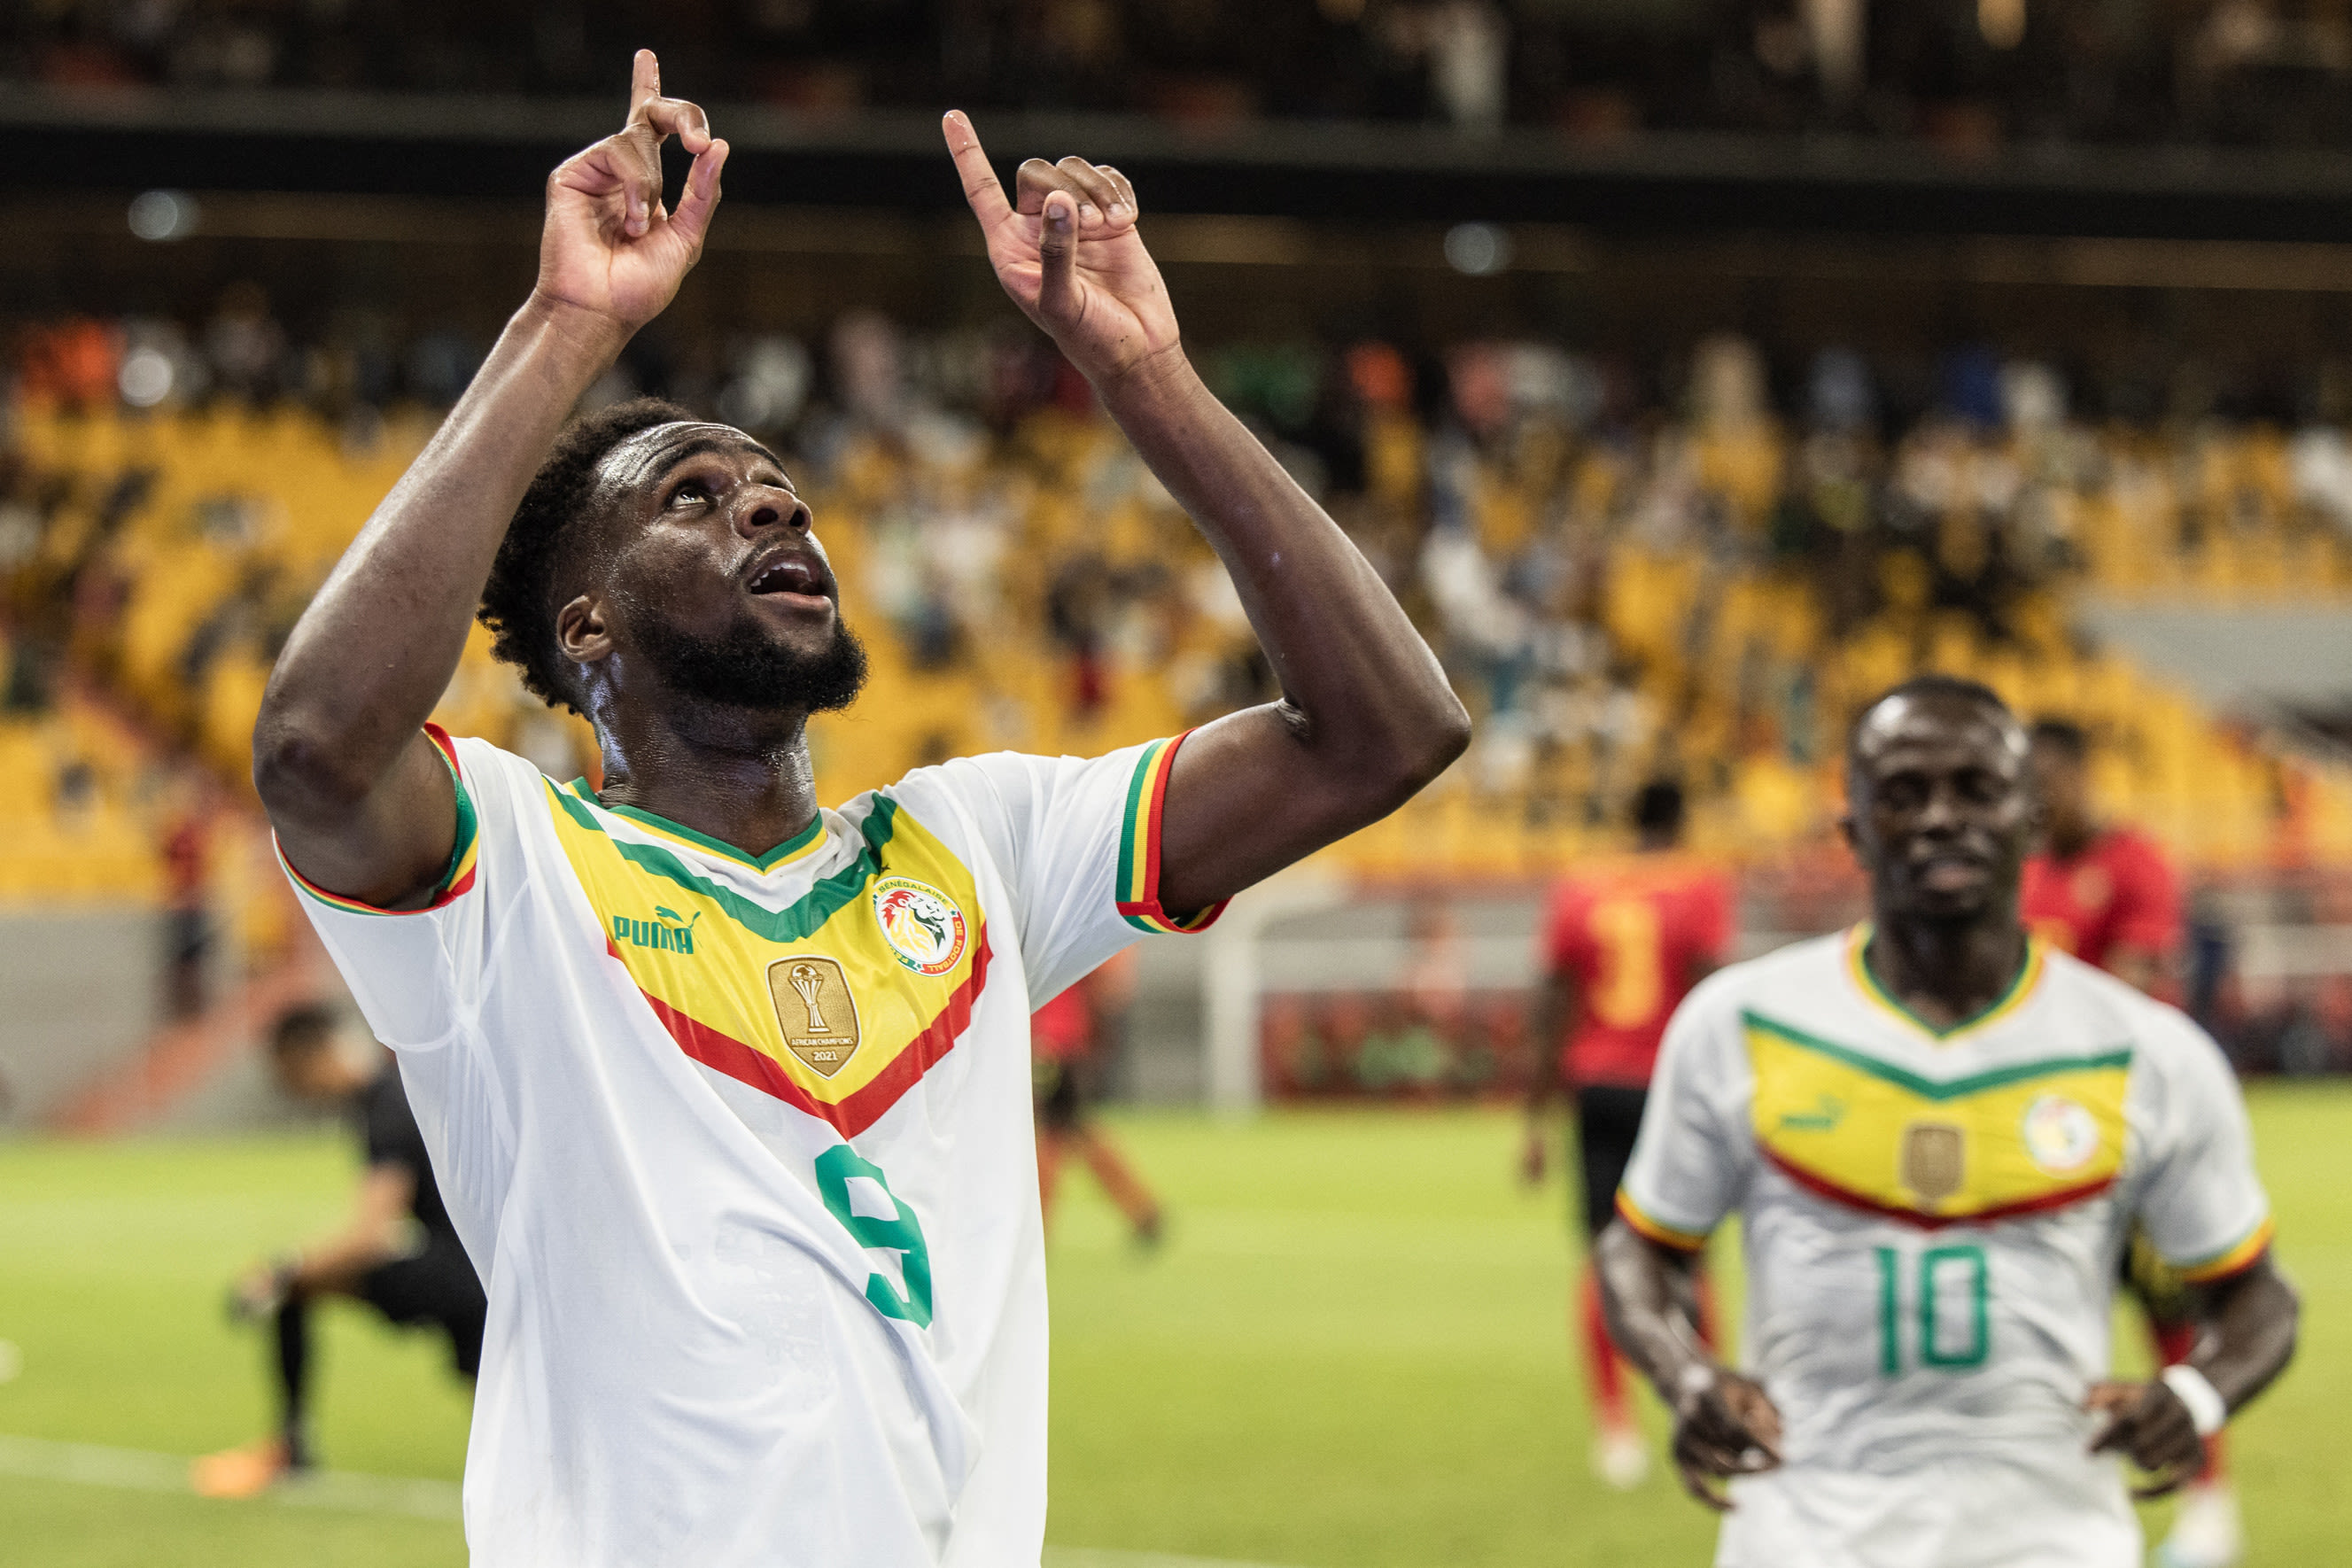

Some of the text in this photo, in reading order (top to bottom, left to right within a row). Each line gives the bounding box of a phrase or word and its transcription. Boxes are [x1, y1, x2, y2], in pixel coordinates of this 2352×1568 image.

[613, 915, 694, 954] PUMA
[928, 939, 963, 972] FOOTBALL
[813, 1051, 838, 1061] 2021
[814, 1144, 933, 1331] 9
[1875, 1245, 1987, 1376] 10
